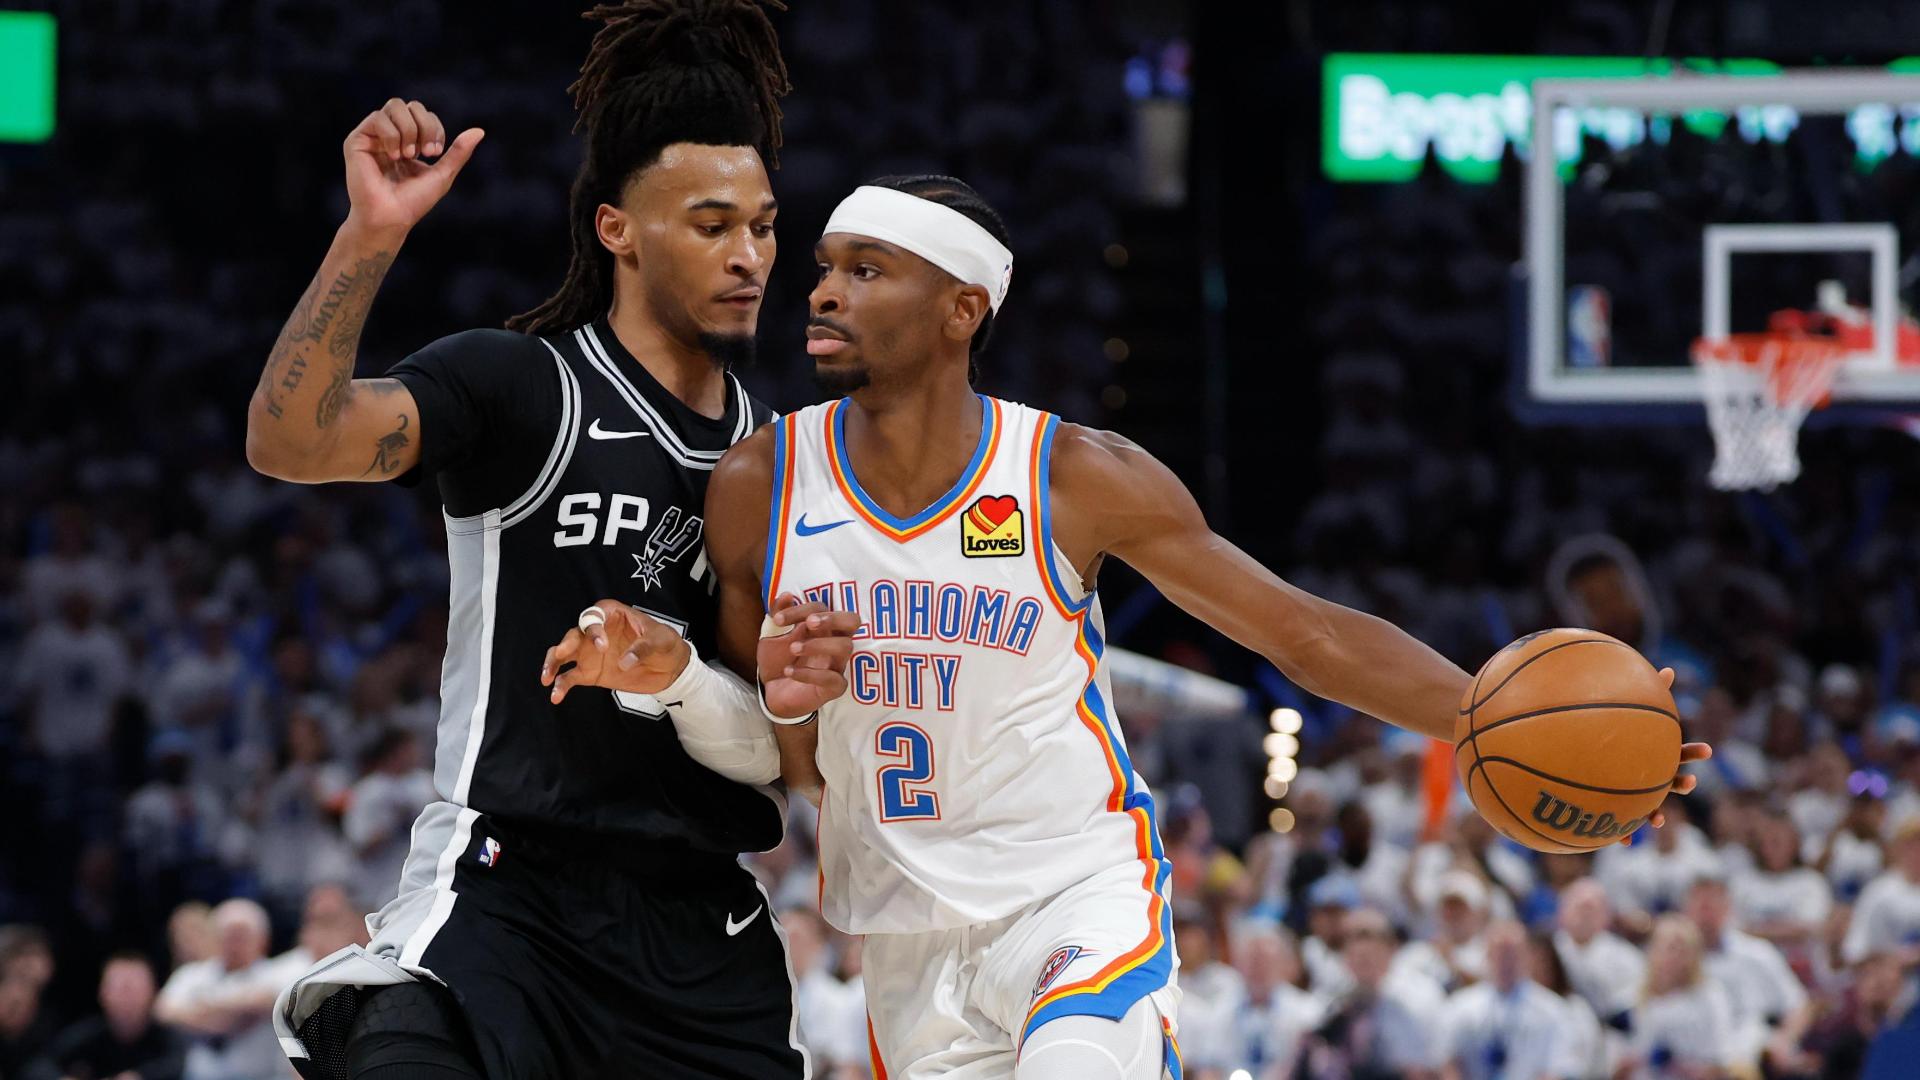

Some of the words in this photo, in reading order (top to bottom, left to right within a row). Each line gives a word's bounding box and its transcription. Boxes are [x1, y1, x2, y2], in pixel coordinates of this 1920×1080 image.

[792, 580, 1044, 656] LAHOMA
[850, 651, 962, 711] CITY
[875, 720, 942, 823] 2
[1532, 791, 1647, 839] Wilso
